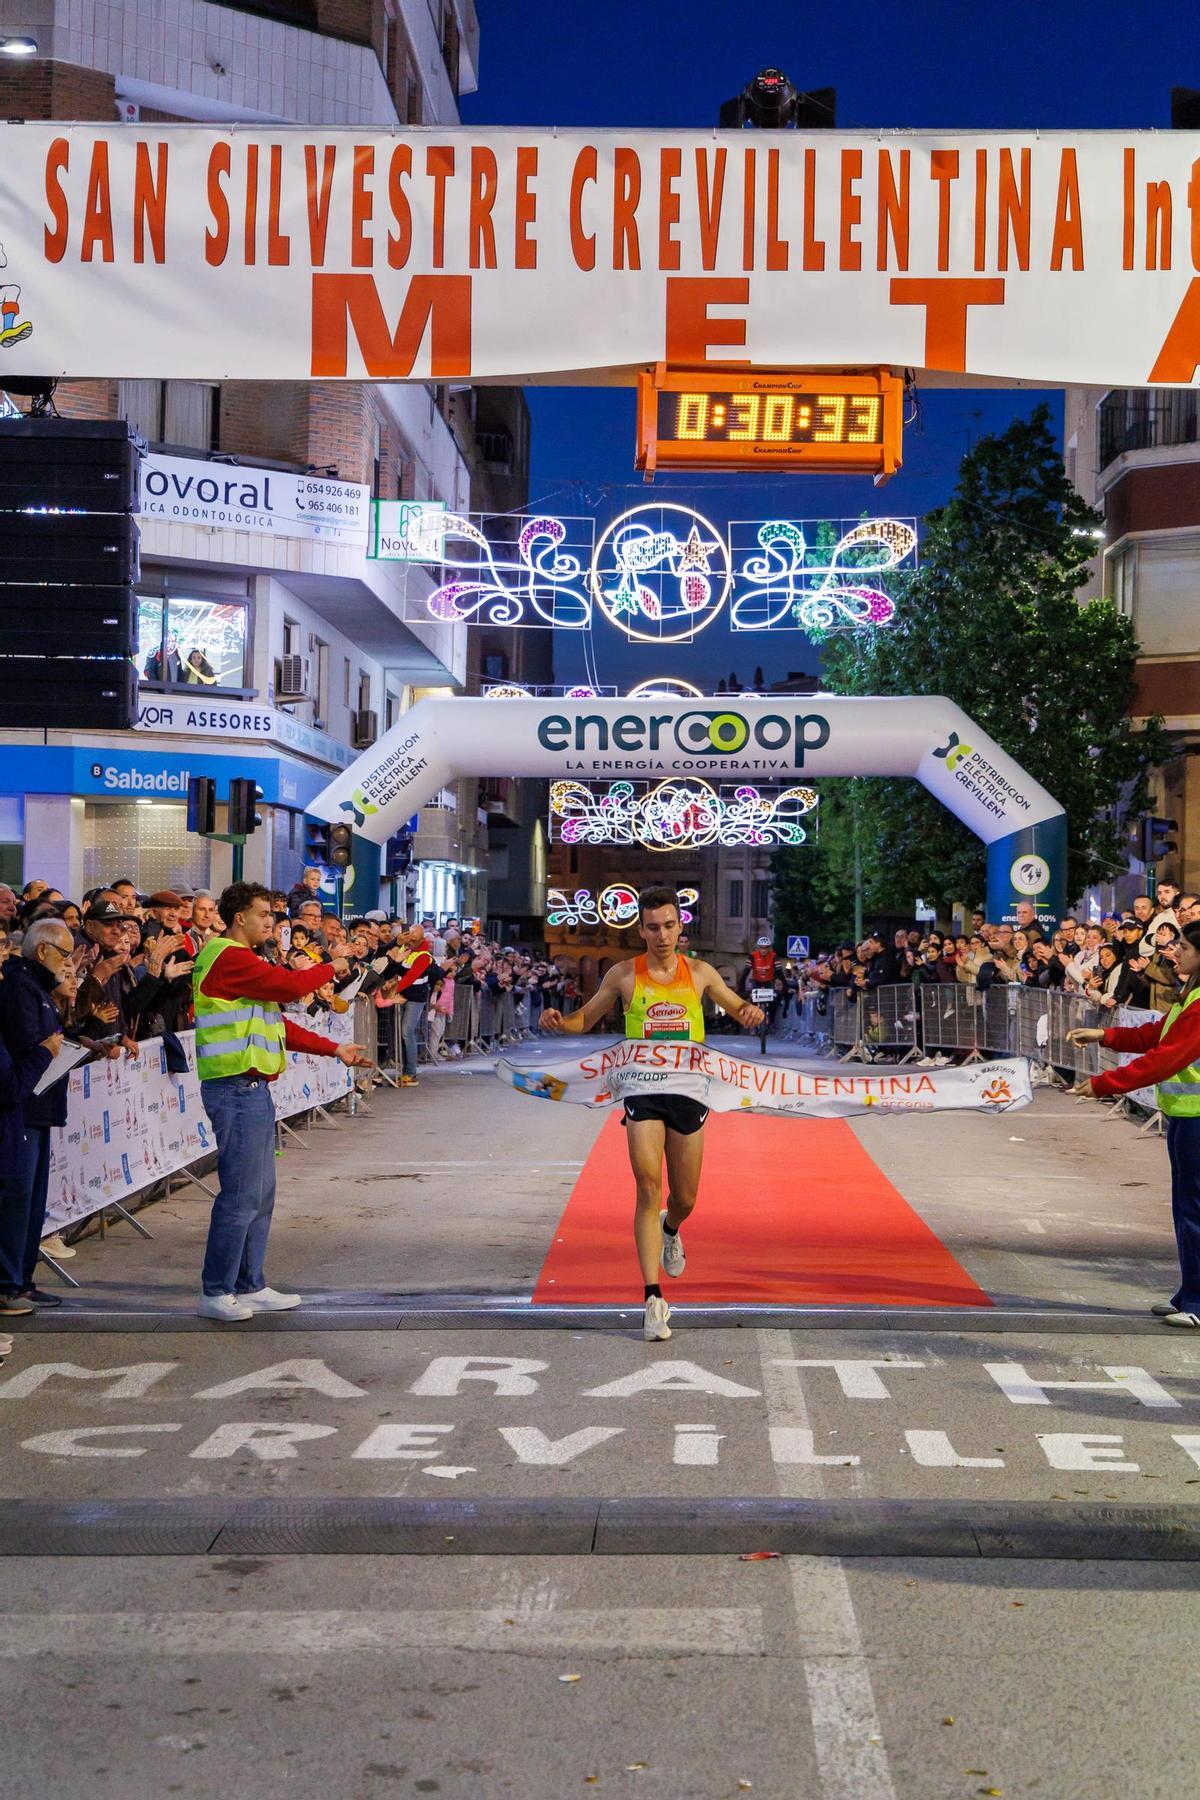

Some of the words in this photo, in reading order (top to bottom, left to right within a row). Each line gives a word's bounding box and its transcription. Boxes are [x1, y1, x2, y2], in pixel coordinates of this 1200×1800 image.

[44, 137, 168, 264] SAN
[205, 140, 539, 271] SILVESTRE
[569, 145, 1085, 272] CREVILLENTINA
[677, 394, 880, 443] 0:30:33
[145, 471, 274, 511] ovoral
[306, 483, 324, 495] 654
[325, 485, 343, 497] 926
[344, 488, 361, 499] 469
[308, 500, 325, 512] 965
[326, 503, 343, 514] 406
[345, 505, 359, 516] 181
[187, 711, 271, 731] ASESORES
[537, 711, 831, 768] enercoop
[104, 767, 190, 792] Sabadell
[361, 732, 420, 790] DISTRIBUCIÓN
[369, 756, 415, 799] ELÉCTRICA
[378, 757, 428, 806] CREVILLENT
[566, 760, 581, 770] LA
[593, 758, 664, 770] ENERGÍA
[672, 760, 790, 770] COOPERATIVA
[971, 752, 1031, 811] DISTRIBUCIÓN
[955, 771, 1006, 819] CREVILLENT
[962, 761, 1006, 806] ELÉCTRICA
[651, 1007, 685, 1016] Serrano
[719, 1057, 937, 1096] CREVILLENTINA
